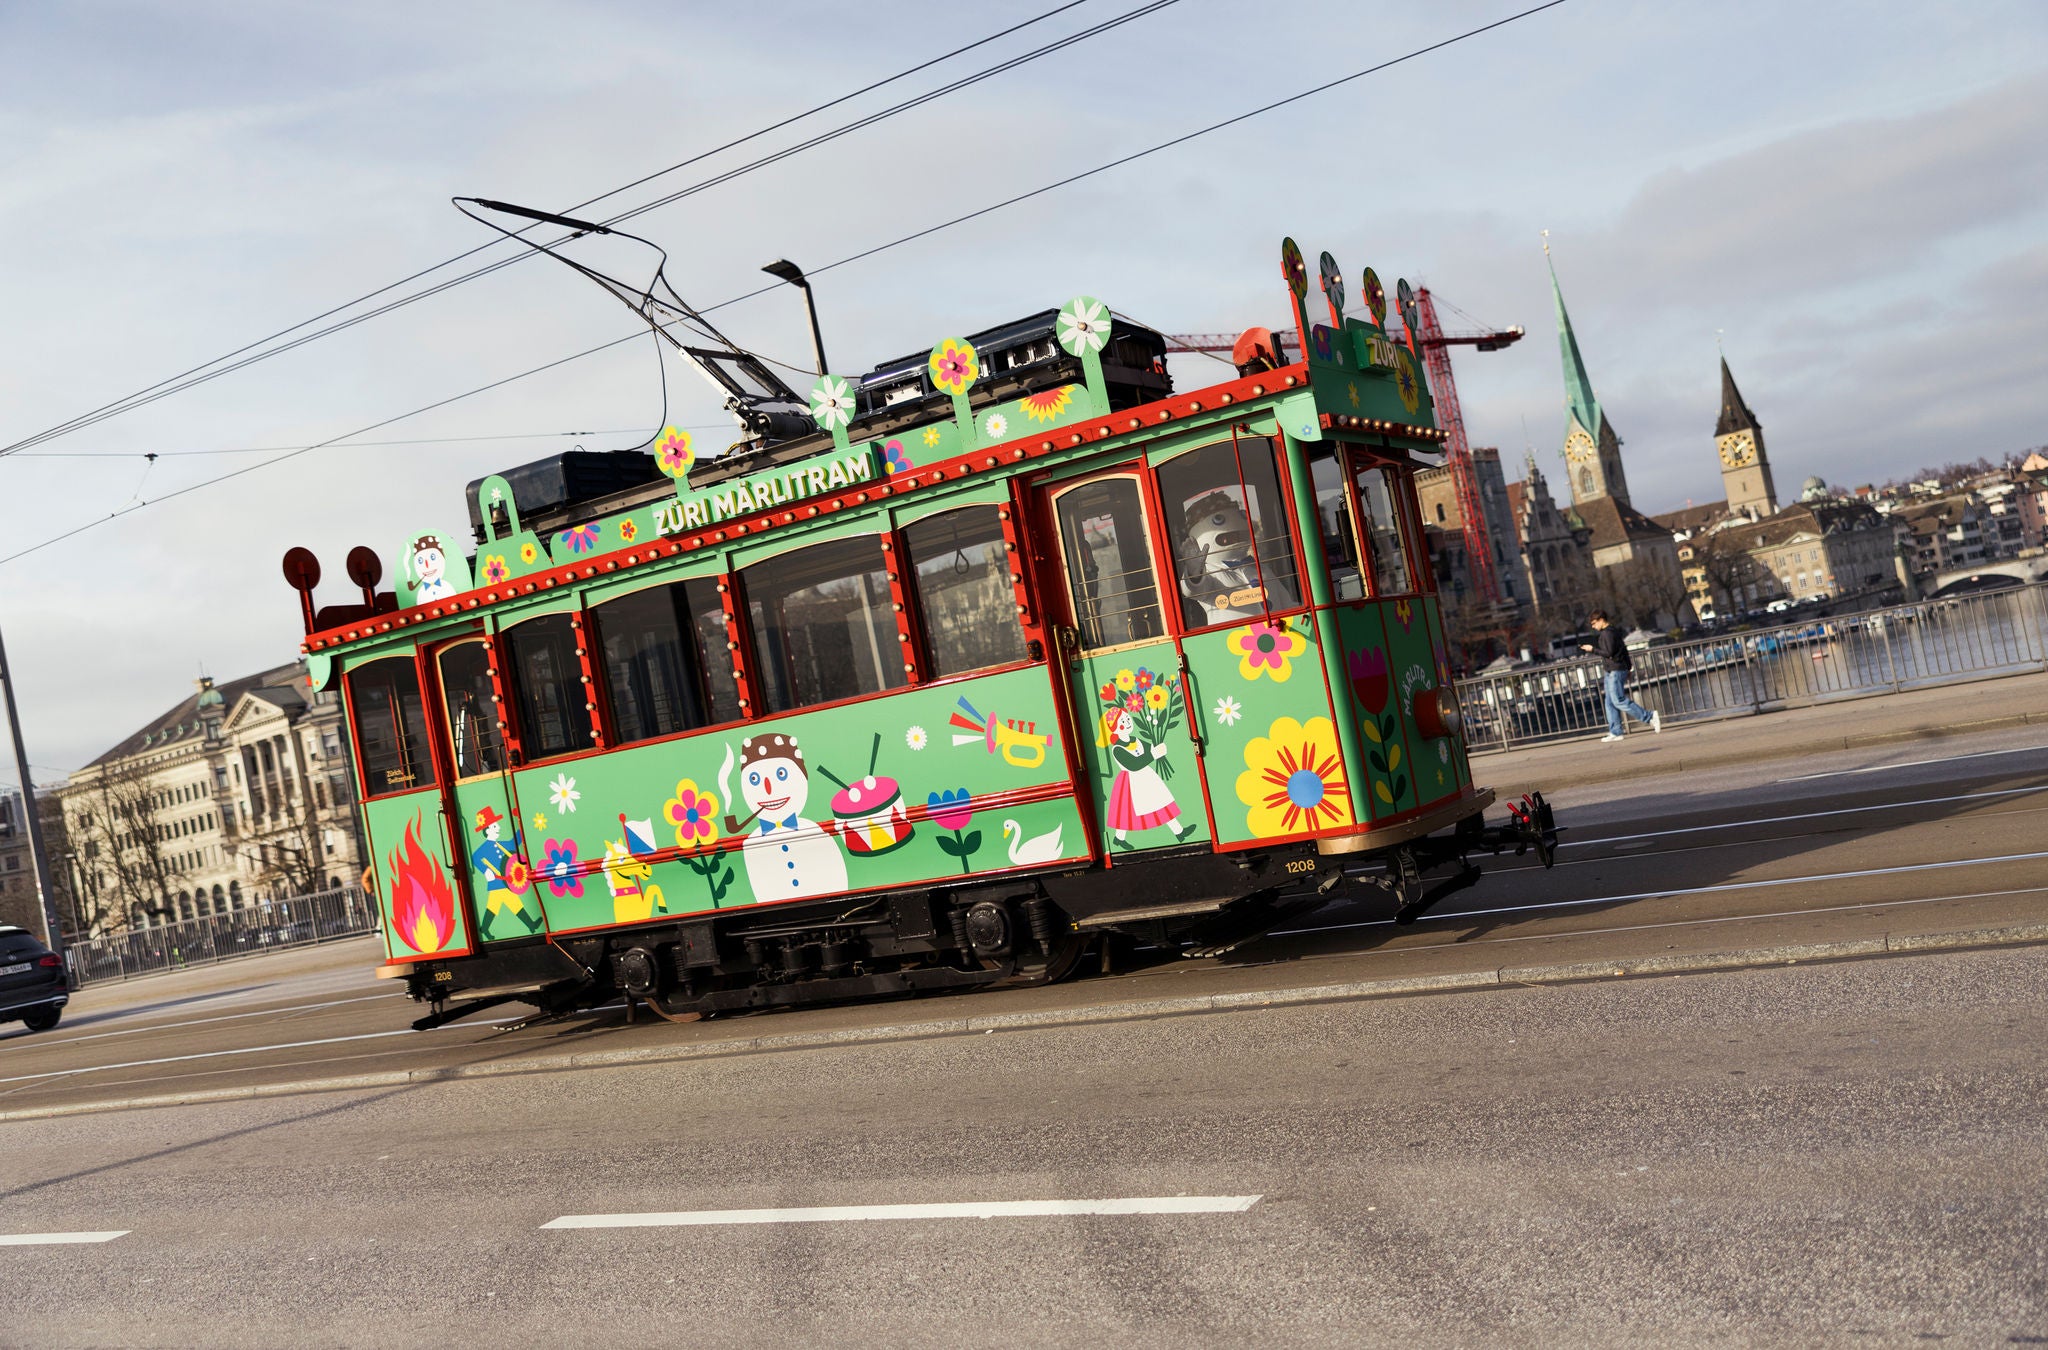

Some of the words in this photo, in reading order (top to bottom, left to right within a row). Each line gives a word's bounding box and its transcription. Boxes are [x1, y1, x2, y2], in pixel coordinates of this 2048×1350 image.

[1366, 333, 1401, 369] ZÜRI
[653, 500, 711, 536] ZÜRI
[714, 452, 872, 519] MÄRLITRAM
[1402, 664, 1431, 716] MÄRLITRA
[1285, 860, 1315, 875] 1208
[434, 970, 452, 981] 1208
